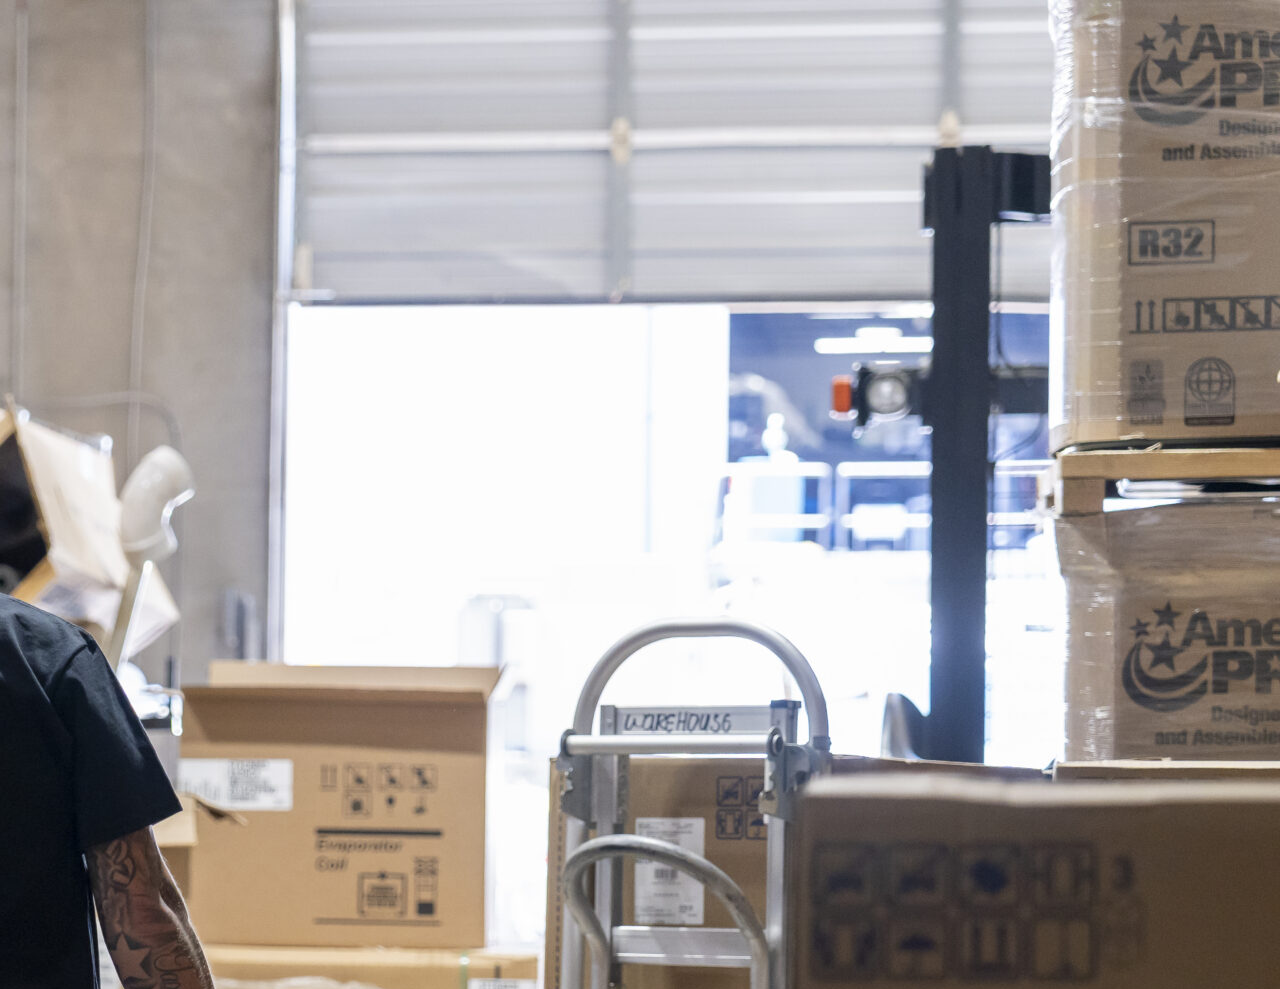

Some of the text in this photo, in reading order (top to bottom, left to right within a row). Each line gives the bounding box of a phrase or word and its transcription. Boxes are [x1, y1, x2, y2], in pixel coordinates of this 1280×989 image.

[1162, 144, 1195, 161] and
[1138, 228, 1204, 258] R32
[1155, 730, 1187, 745] and
[315, 857, 348, 871] Coil
